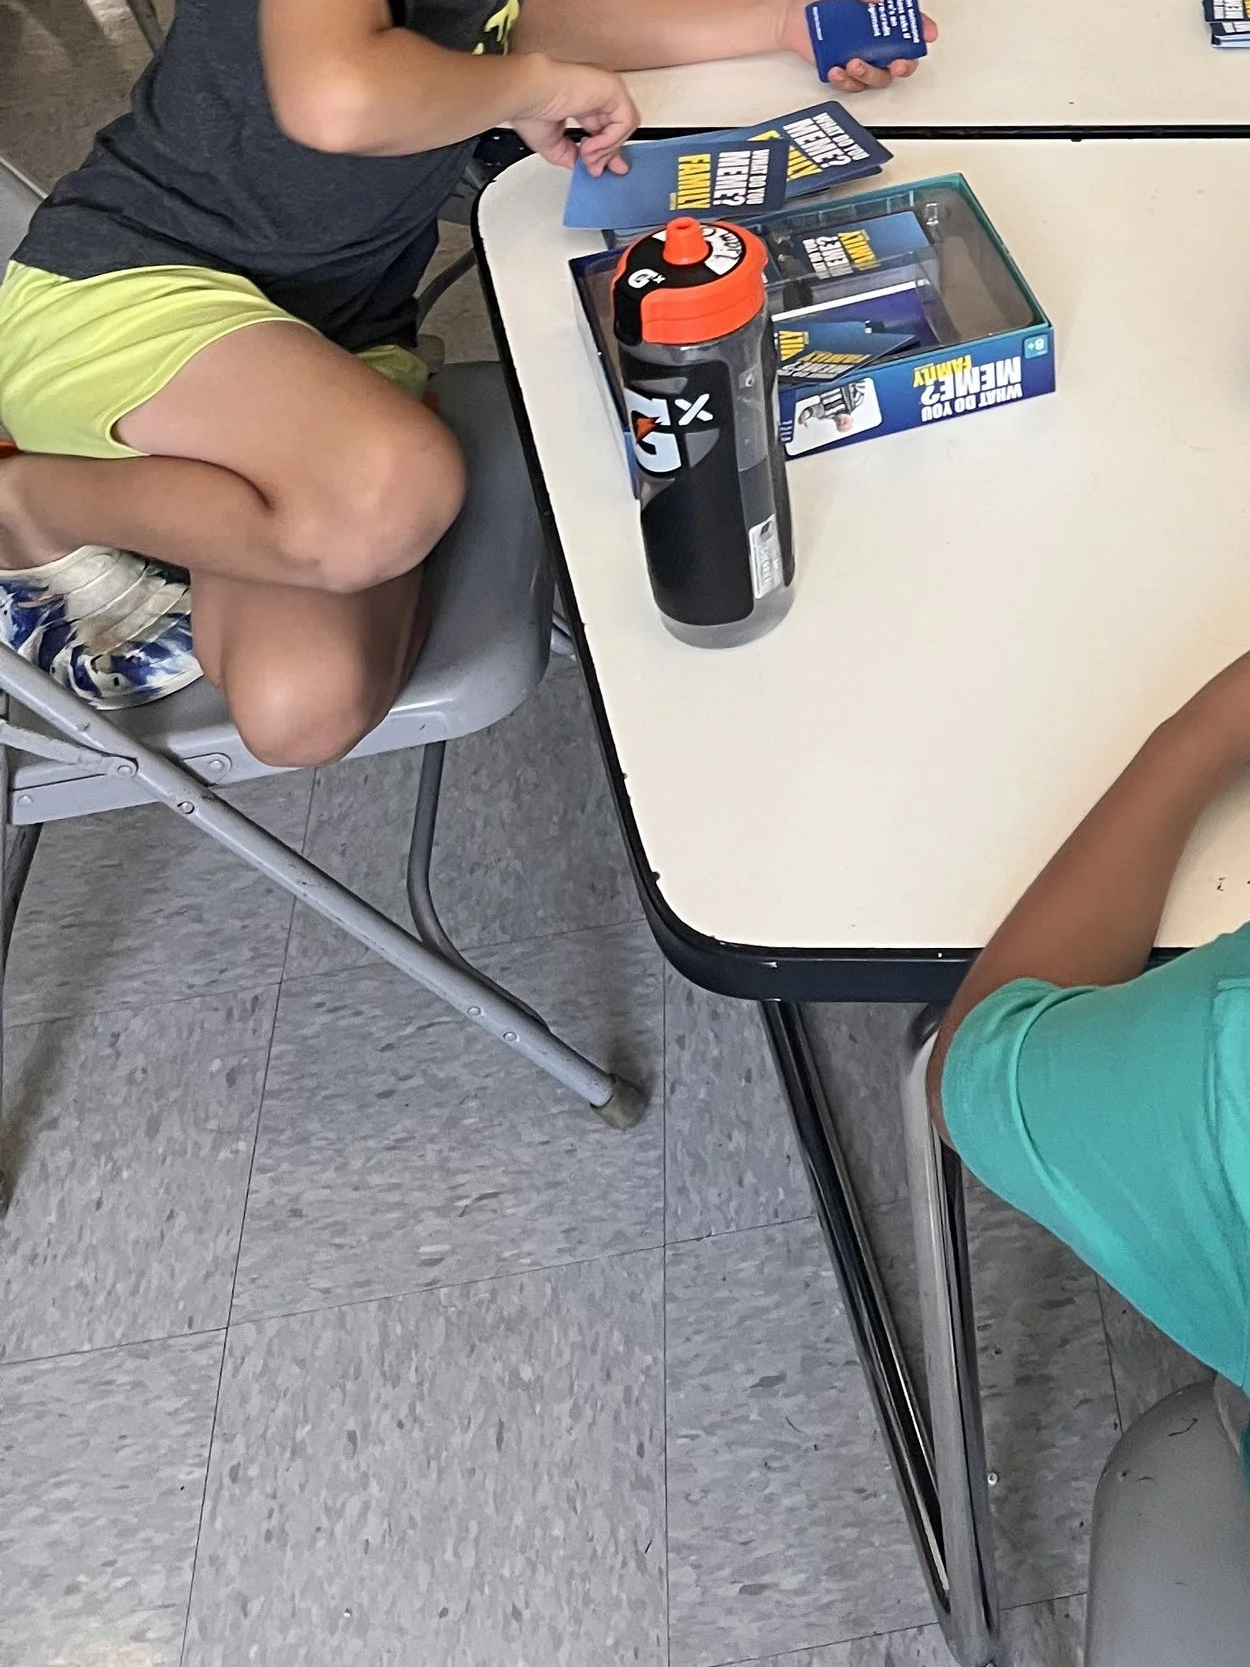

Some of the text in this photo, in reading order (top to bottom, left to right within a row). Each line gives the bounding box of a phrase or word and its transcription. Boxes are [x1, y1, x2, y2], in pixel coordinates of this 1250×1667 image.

[782, 118, 852, 169] MEME?
[812, 112, 870, 161] WHAT DO YOU
[677, 154, 711, 210] FAMILY
[713, 150, 751, 206] MEME?
[746, 149, 770, 205] WHAT DO YOU
[913, 355, 973, 389] FAMILY
[920, 356, 1023, 406] MEME?
[921, 383, 1023, 423] WHAT DO YOU
